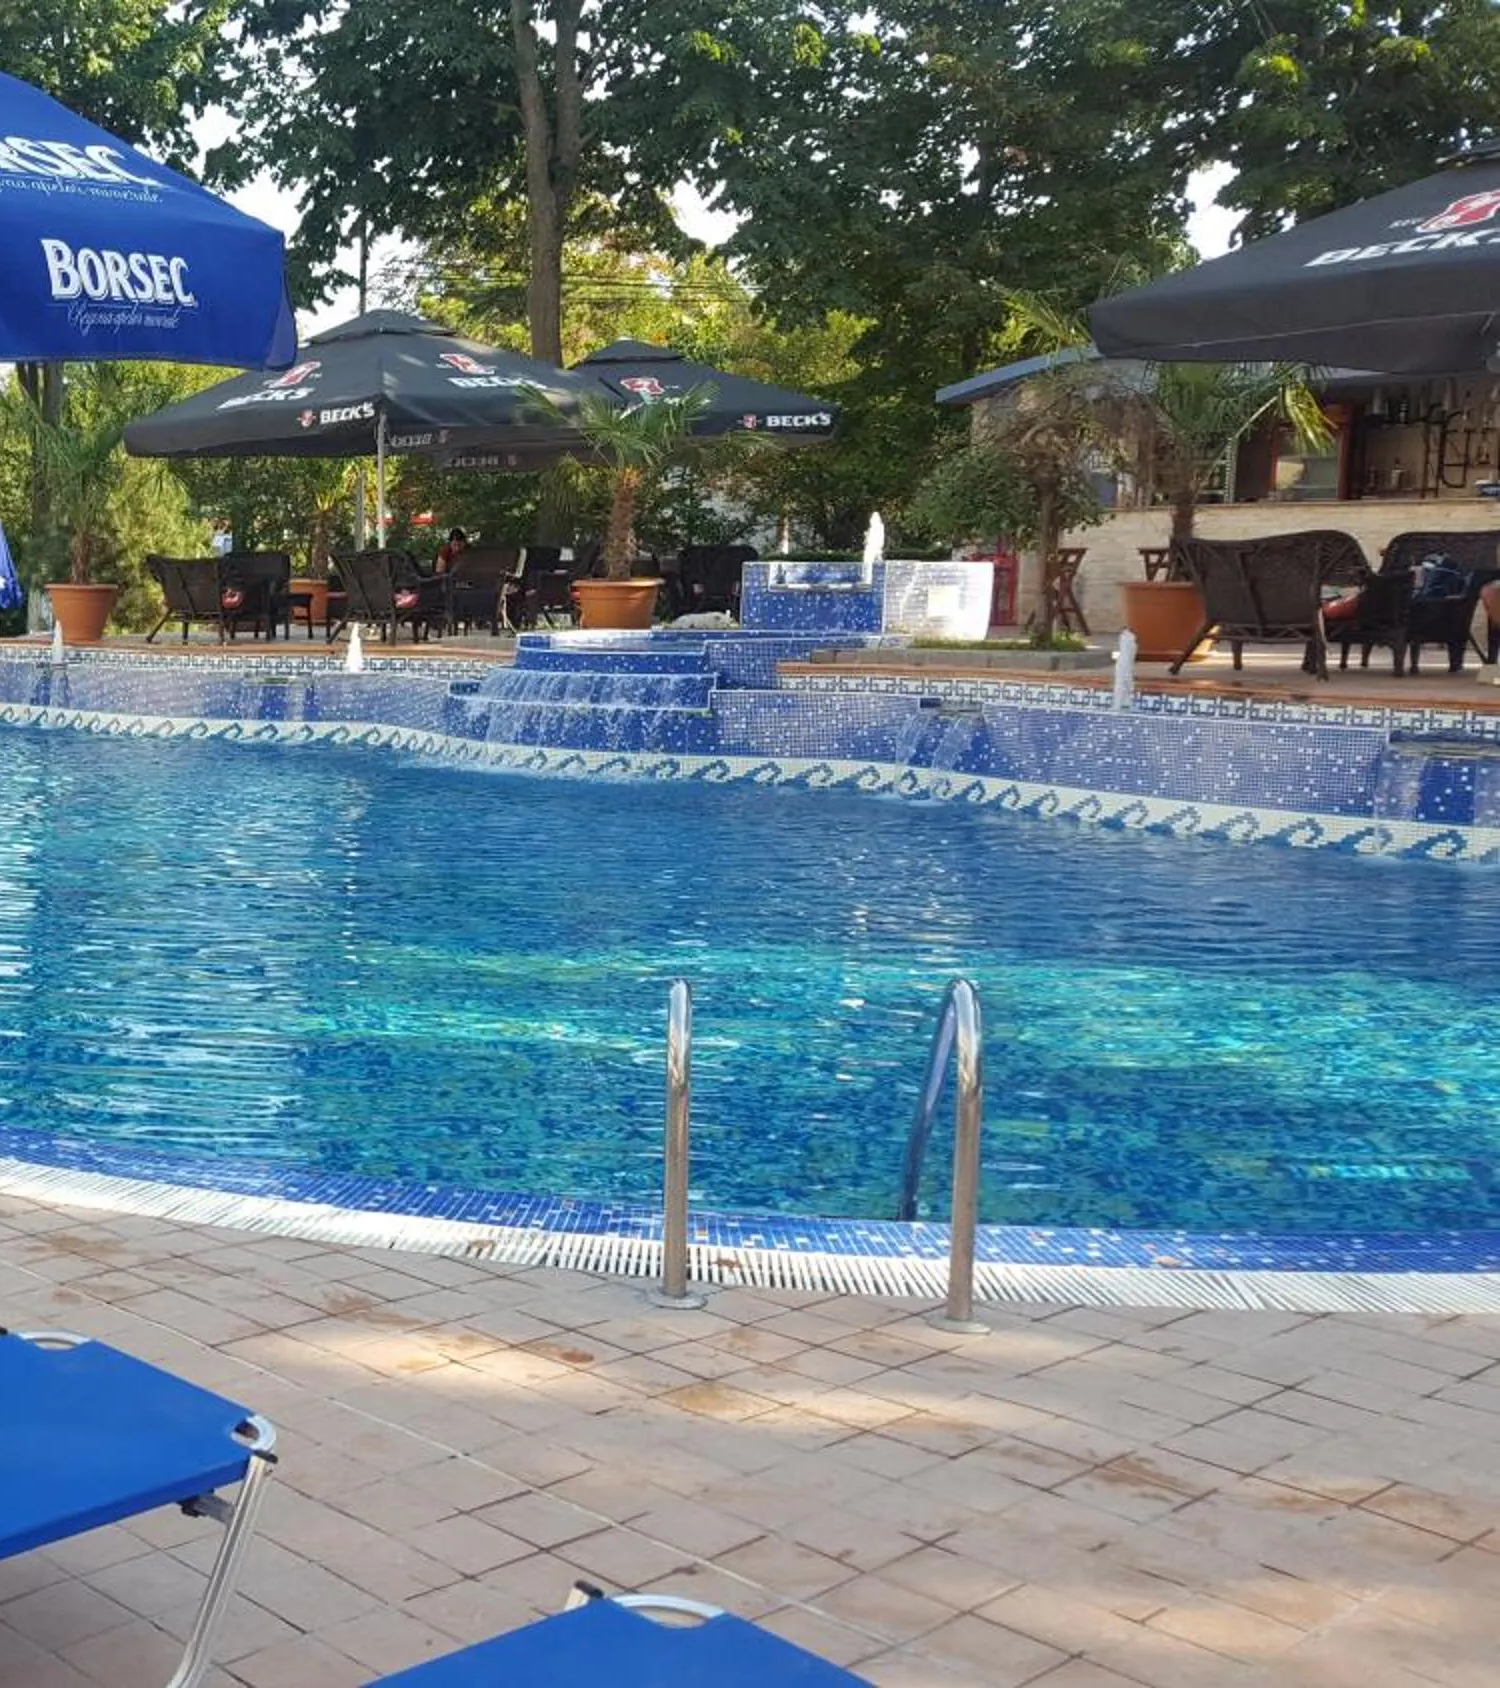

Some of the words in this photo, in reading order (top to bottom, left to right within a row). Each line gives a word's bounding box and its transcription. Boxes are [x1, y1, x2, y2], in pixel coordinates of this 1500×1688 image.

[41, 238, 198, 308] BORSEC
[320, 401, 376, 425] BECK'S
[766, 411, 833, 428] BECK'S
